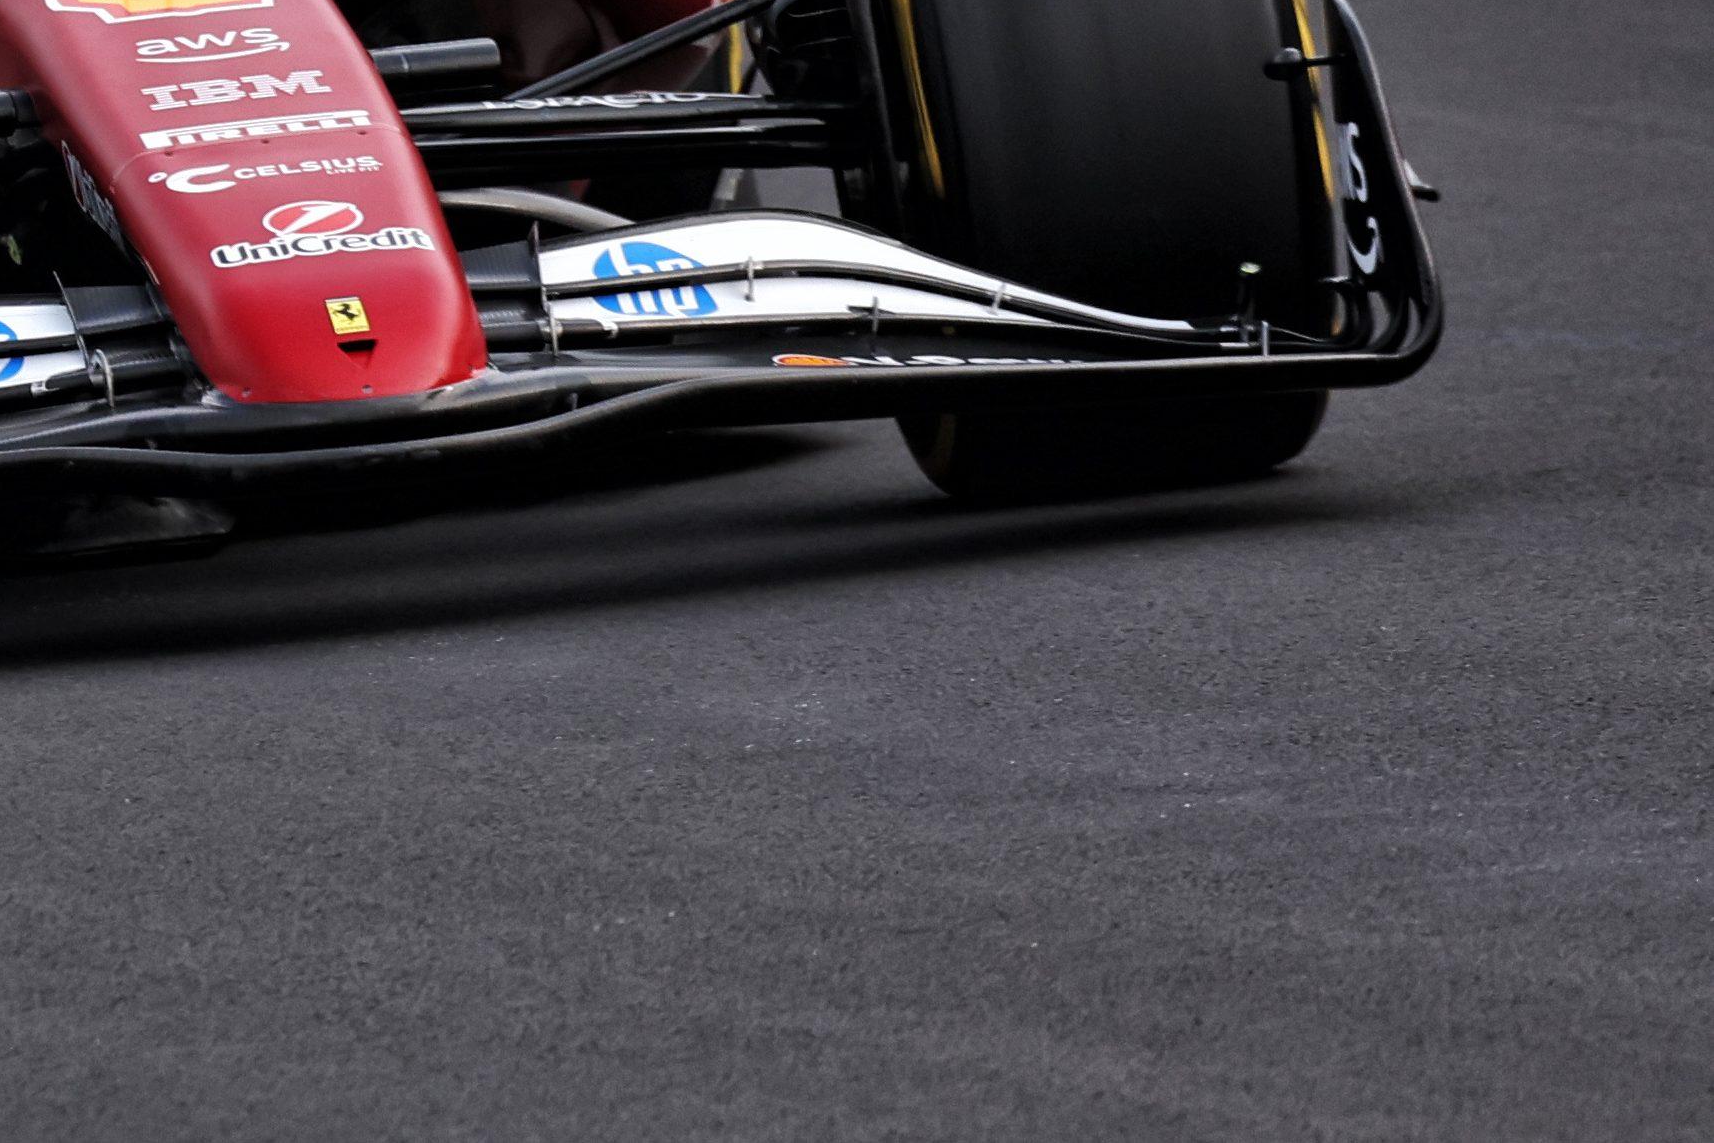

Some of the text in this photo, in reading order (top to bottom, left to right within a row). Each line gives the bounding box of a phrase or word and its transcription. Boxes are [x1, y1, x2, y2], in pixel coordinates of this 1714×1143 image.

[135, 27, 281, 57] aws
[140, 69, 334, 112] IBM
[138, 109, 373, 151] PIRELLI
[233, 155, 379, 180] CELSIUS
[216, 228, 431, 266] UniCredit
[607, 241, 701, 317] hp
